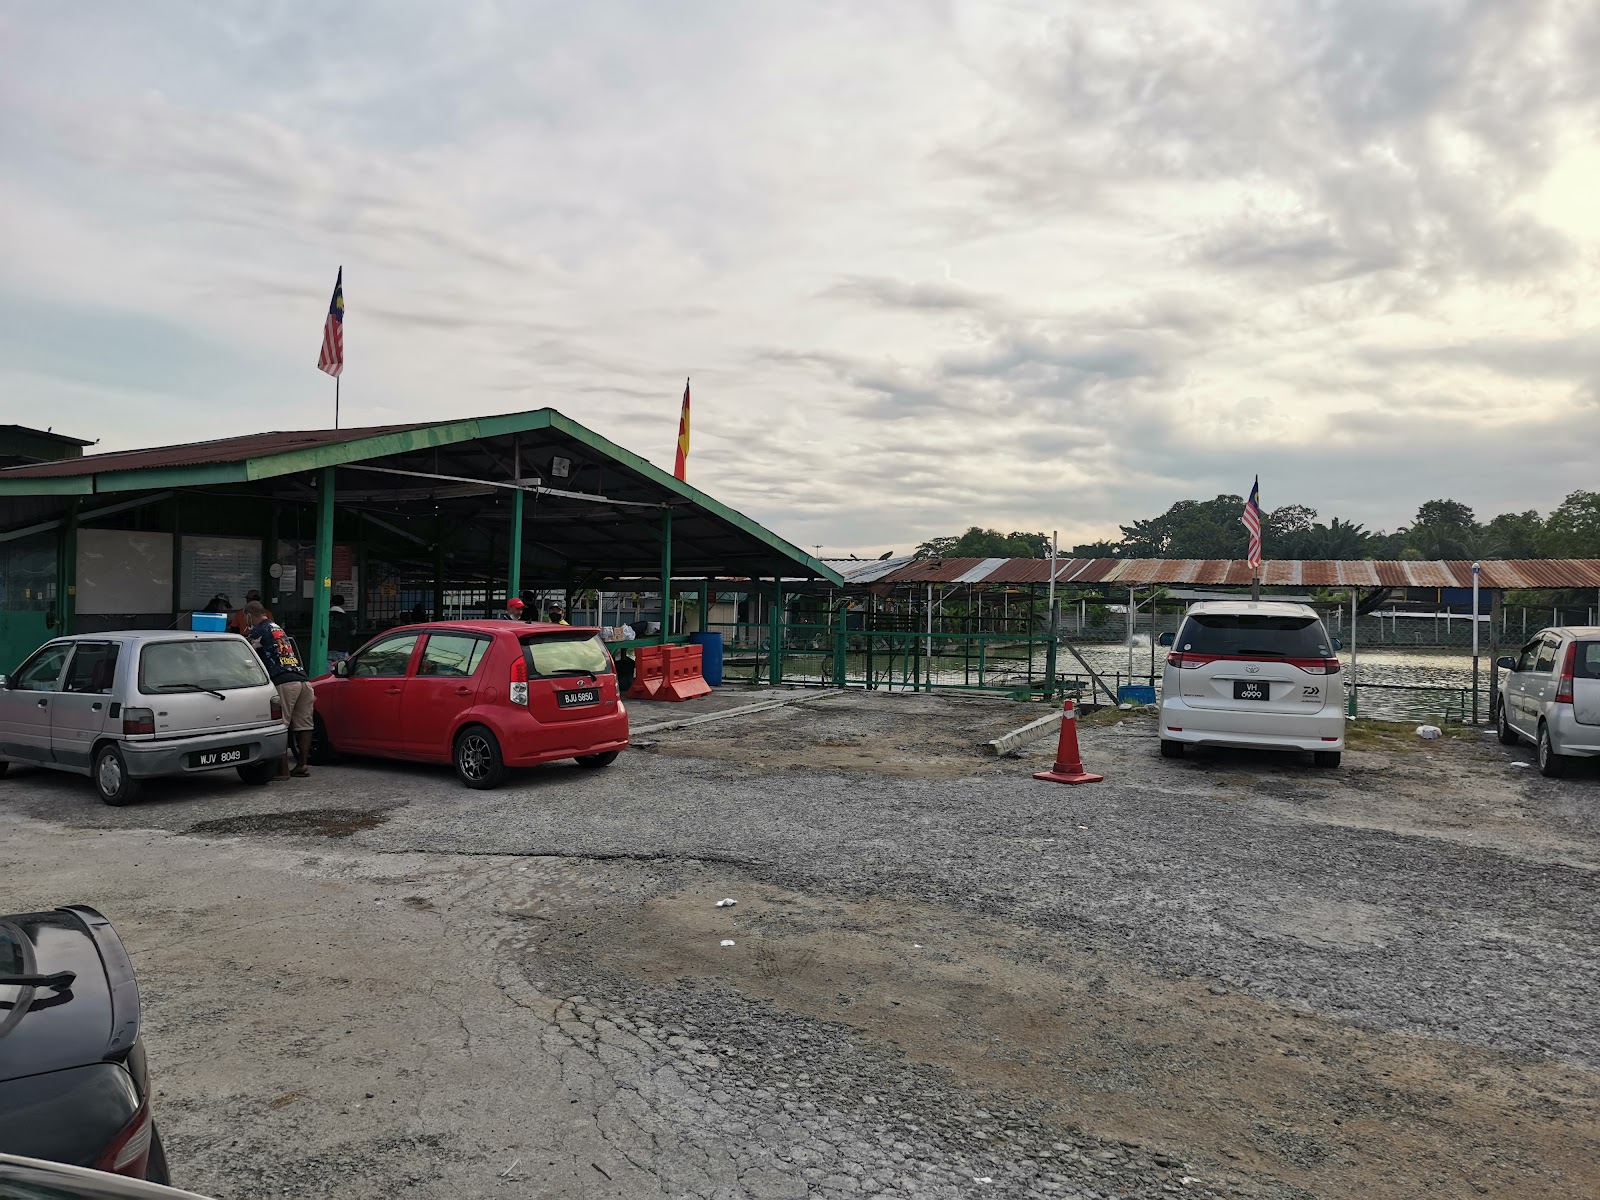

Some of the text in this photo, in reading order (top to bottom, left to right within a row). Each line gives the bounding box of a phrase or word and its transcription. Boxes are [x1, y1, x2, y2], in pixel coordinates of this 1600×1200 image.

[1246, 683, 1258, 691] VH
[564, 693, 578, 703] BJU
[1240, 690, 1262, 699] 6999
[200, 750, 241, 765] WJV 8049
